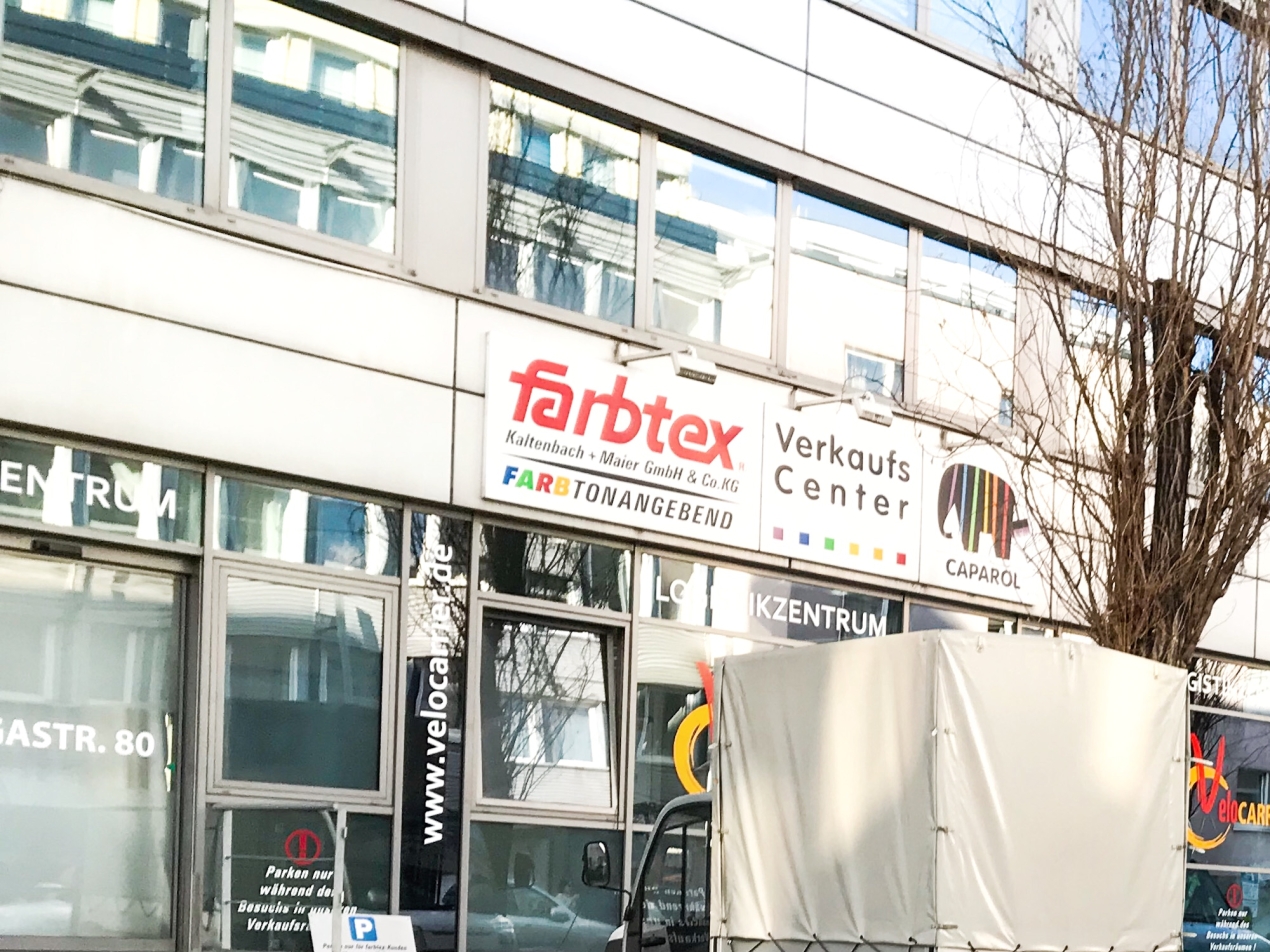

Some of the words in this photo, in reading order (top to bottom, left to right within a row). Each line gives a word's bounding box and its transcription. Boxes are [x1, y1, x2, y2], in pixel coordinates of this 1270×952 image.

[508, 359, 744, 471] farbtex
[505, 429, 584, 460] Kaltenbach
[588, 452, 596, 460] +
[600, 450, 640, 471] Maier
[644, 460, 684, 481] GmbH
[687, 470, 697, 484] &
[775, 422, 910, 482] Verkaufs
[502, 465, 734, 530] FARBTONANGEBEND
[775, 464, 909, 520] Center
[945, 558, 1021, 589] CAPAROL
[419, 544, 452, 845] www.velocarrier.de
[0, 717, 106, 754] ASTR.
[114, 729, 155, 758] 80
[260, 883, 314, 896] während
[265, 865, 309, 880] Parken
[312, 870, 334, 880] nur
[238, 899, 290, 914] Besuchs
[1218, 908, 1237, 917] Parken
